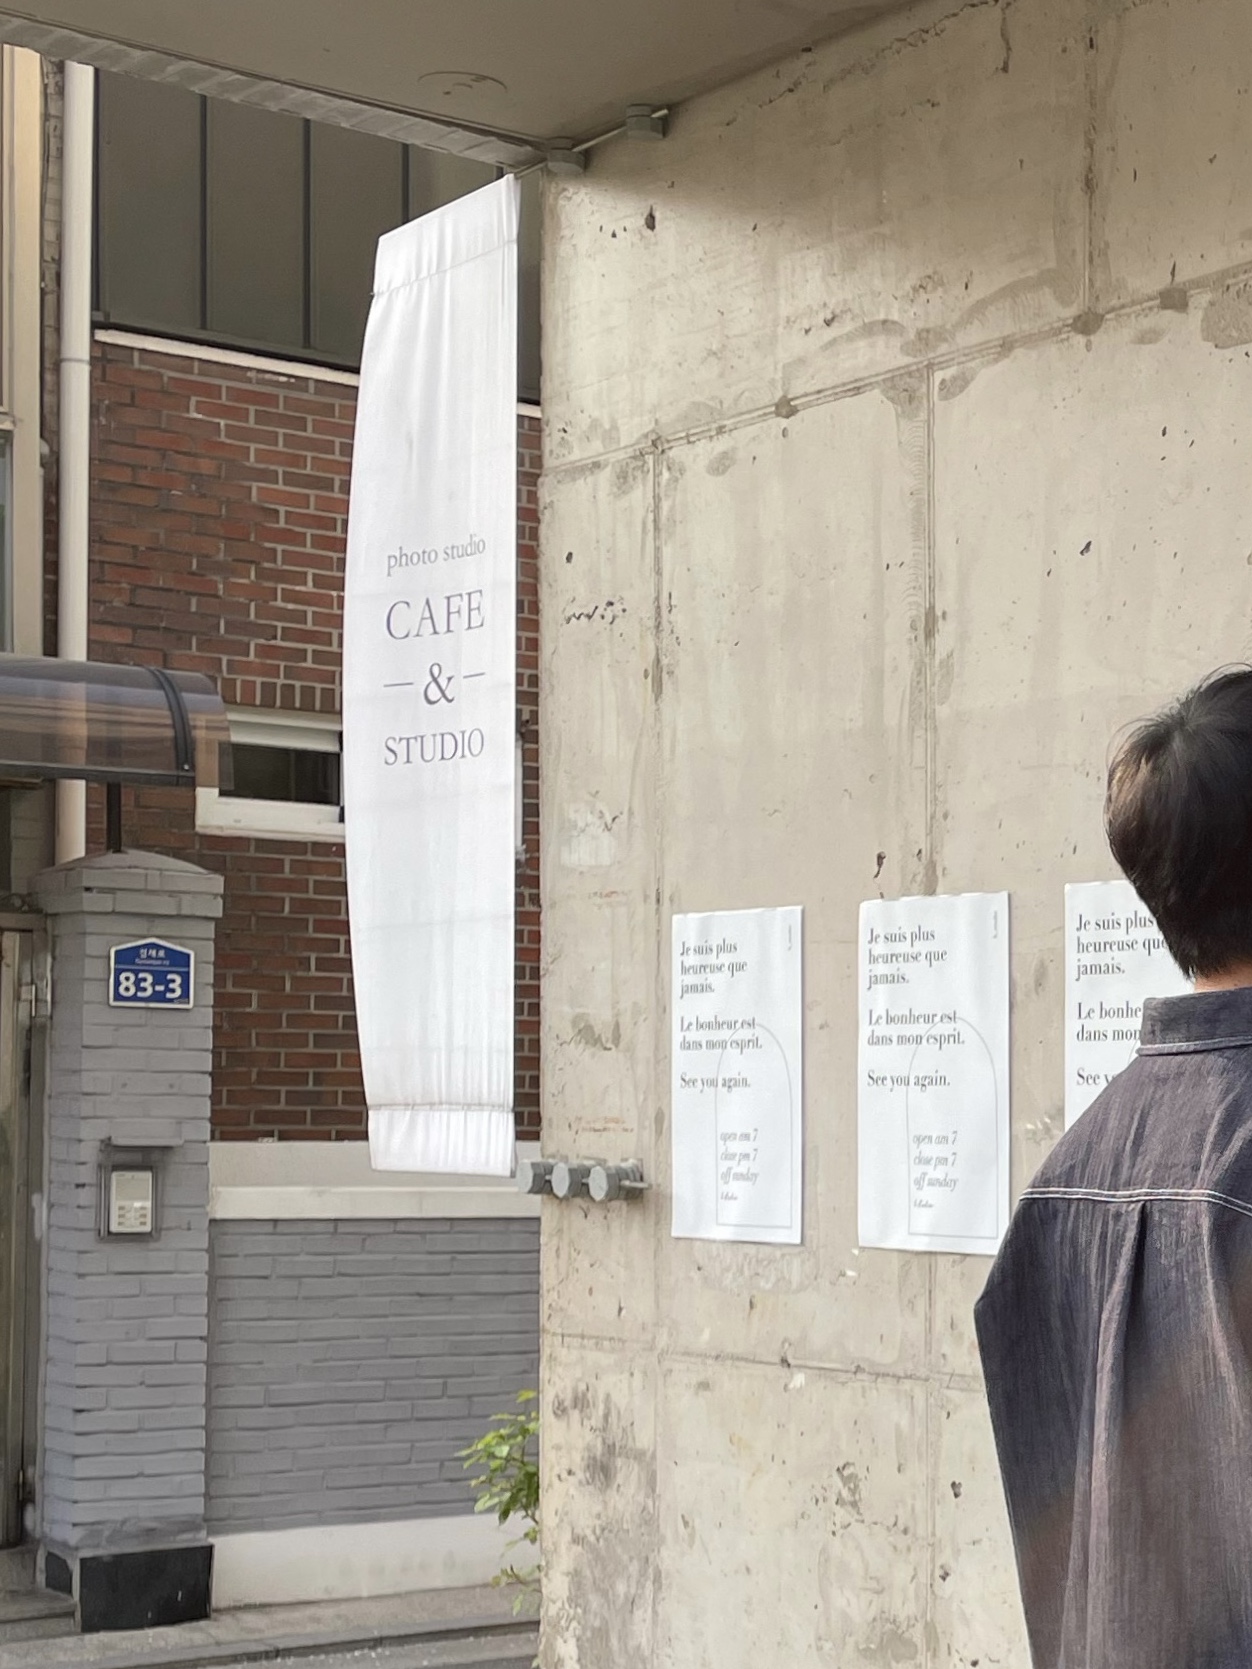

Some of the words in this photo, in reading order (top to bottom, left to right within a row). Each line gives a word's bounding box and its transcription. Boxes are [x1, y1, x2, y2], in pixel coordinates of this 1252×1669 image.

[387, 546, 438, 577] photo
[443, 533, 486, 561] studio
[386, 589, 485, 640] CAFE
[384, 727, 485, 766] STUDIO
[1076, 914, 1091, 932] Je
[1094, 912, 1121, 930] suis
[1125, 910, 1154, 935] plus
[867, 928, 881, 944] Je
[883, 927, 907, 943] suis
[910, 925, 935, 948] plus
[1076, 936, 1138, 954] heureuse
[680, 941, 691, 956] Je
[693, 940, 713, 955] suis
[716, 938, 738, 959] plus
[868, 948, 921, 965] heureuse
[925, 948, 947, 967] que
[681, 960, 725, 975] heureuse
[728, 961, 748, 978] que
[867, 968, 909, 990] jamais.
[1075, 957, 1125, 981] jamais.
[118, 971, 182, 999] 83-3
[680, 978, 715, 999] jamais.
[868, 1009, 882, 1026] Le
[886, 1008, 937, 1025] bonheur
[940, 1010, 957, 1024] est
[1077, 1002, 1095, 1020] Le
[1099, 1000, 1142, 1019] bonhe
[680, 1016, 693, 1032] Le
[696, 1015, 739, 1031] bonheur
[741, 1017, 756, 1030] est
[1076, 1024, 1108, 1042] dans
[680, 1035, 703, 1051] dans
[705, 1040, 727, 1050] mon
[730, 1033, 762, 1055] esprit.
[867, 1030, 893, 1046] dans
[897, 1034, 922, 1046] mon
[926, 1028, 965, 1050] esprit.
[680, 1072, 698, 1088] See
[700, 1077, 718, 1093] you
[721, 1072, 751, 1093] again.
[867, 1070, 887, 1087] See
[890, 1074, 910, 1092] you
[914, 1070, 950, 1092] again.
[1076, 1067, 1100, 1086] See
[912, 1134, 932, 1149] open
